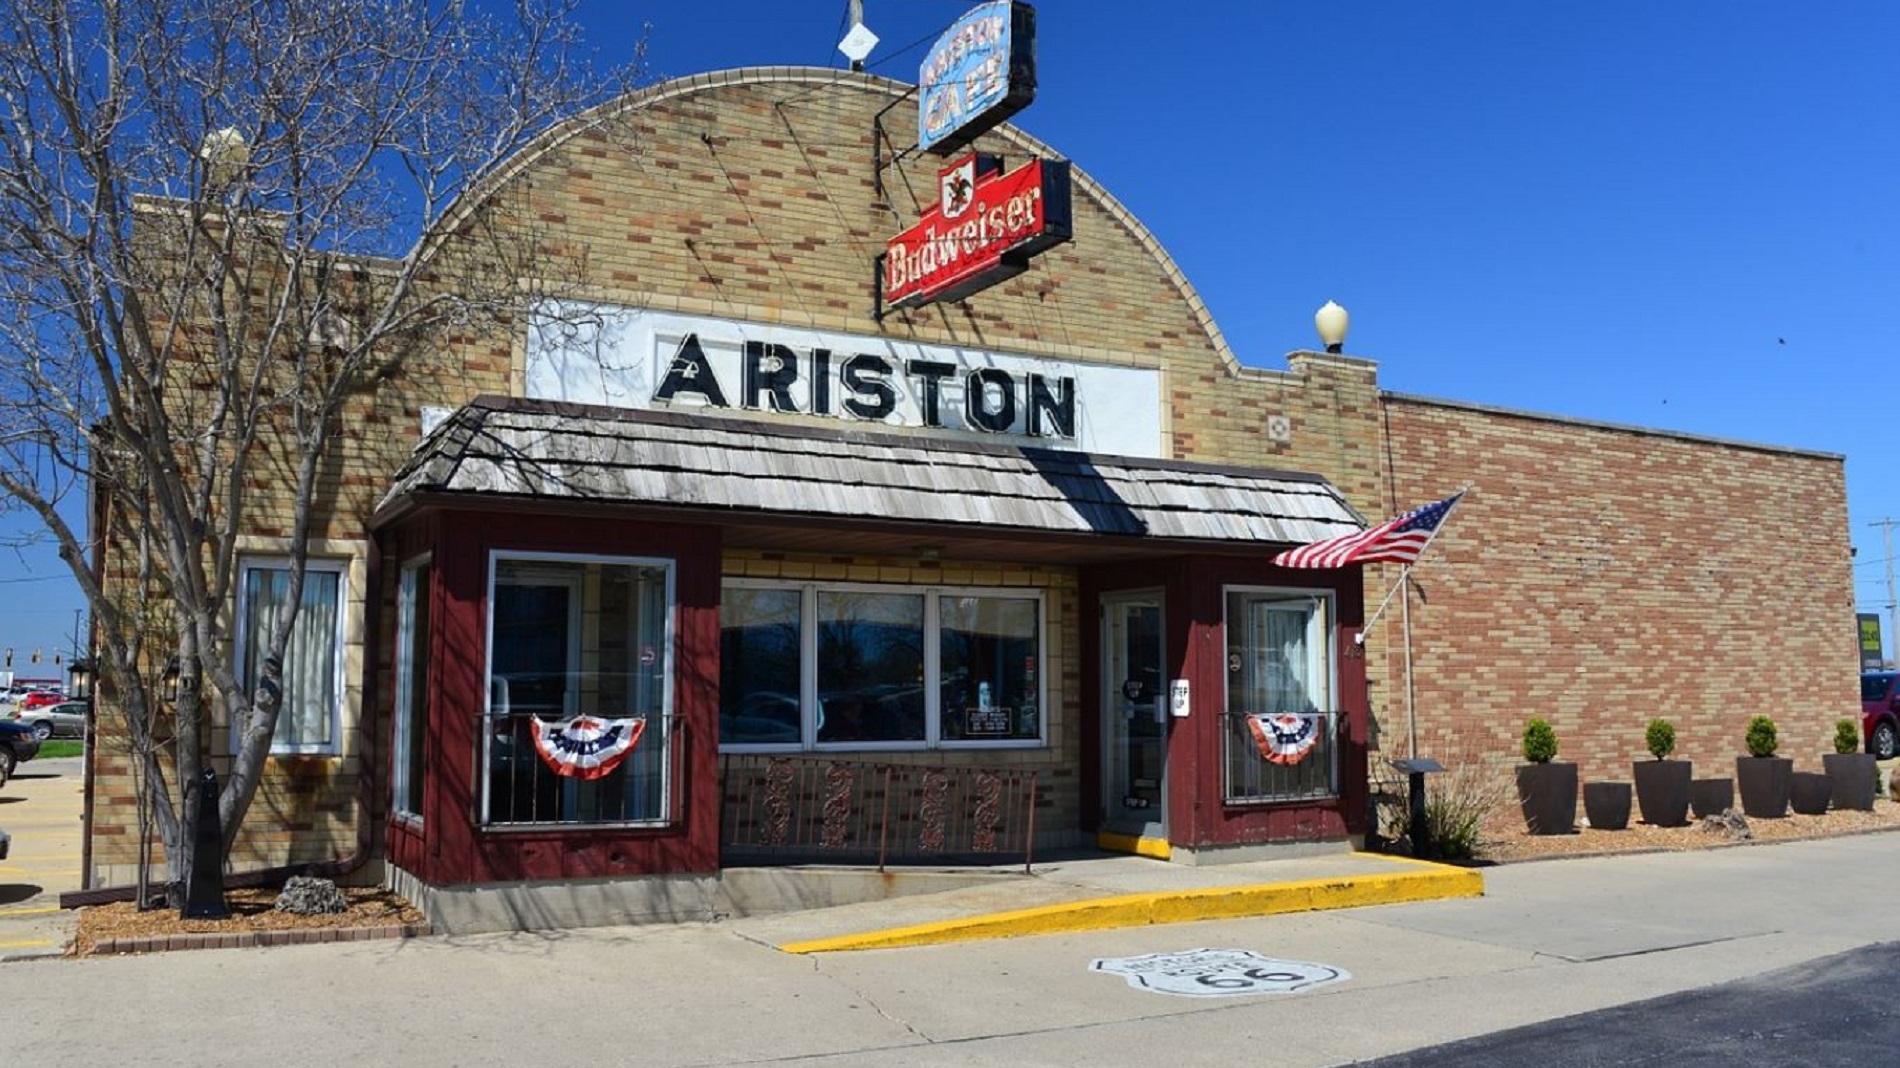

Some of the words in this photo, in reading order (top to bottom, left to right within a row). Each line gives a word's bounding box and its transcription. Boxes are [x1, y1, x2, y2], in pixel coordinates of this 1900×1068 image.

[926, 49, 1003, 133] CAFE
[888, 187, 1041, 291] Budweiser
[652, 331, 1077, 439] ARISTON
[1195, 967, 1305, 988] 66
